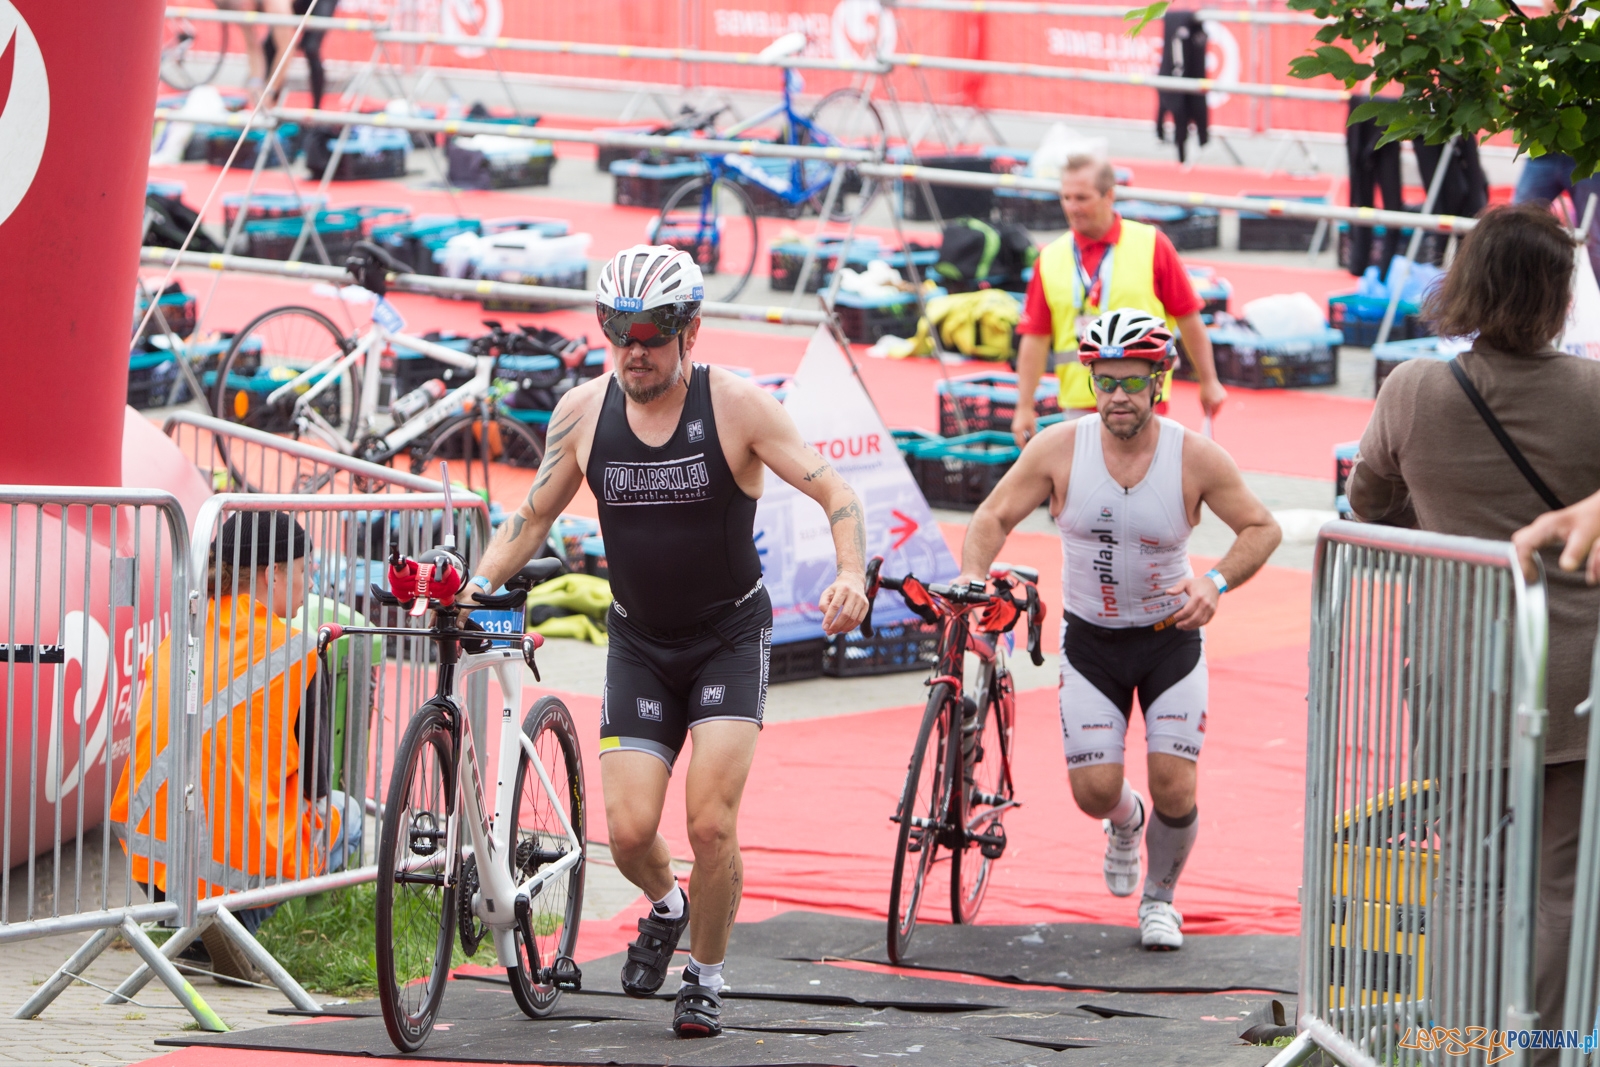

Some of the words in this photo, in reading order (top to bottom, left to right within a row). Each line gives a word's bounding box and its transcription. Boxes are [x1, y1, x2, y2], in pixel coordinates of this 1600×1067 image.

[604, 461, 710, 500] KOLARSKI.EU
[623, 491, 669, 500] triathlon
[674, 489, 706, 499] brands
[1091, 529, 1119, 617] ironpila.pl
[703, 687, 722, 700] SMS
[640, 699, 660, 715] SMS
